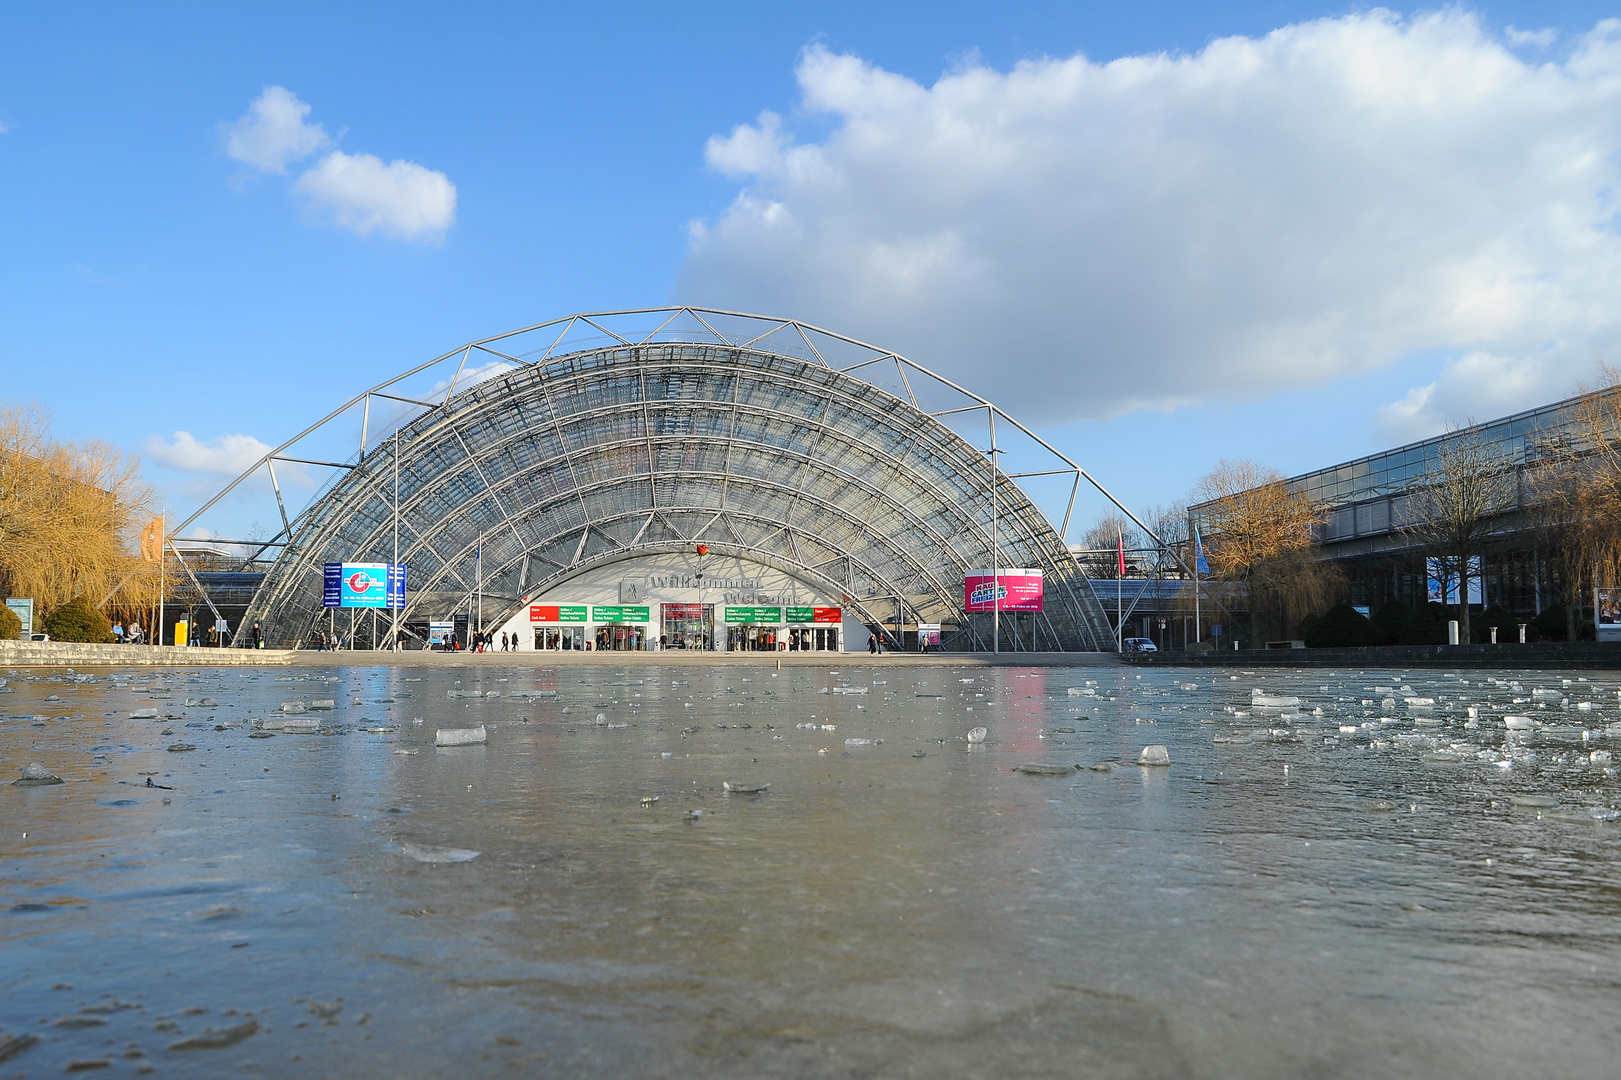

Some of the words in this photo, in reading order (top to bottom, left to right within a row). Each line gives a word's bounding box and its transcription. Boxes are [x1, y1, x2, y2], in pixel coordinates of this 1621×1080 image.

[651, 575, 765, 589] Willkommen.
[972, 586, 1005, 597] GARTN
[724, 592, 809, 605] Welcome.
[971, 592, 1006, 604] FREIZIT
